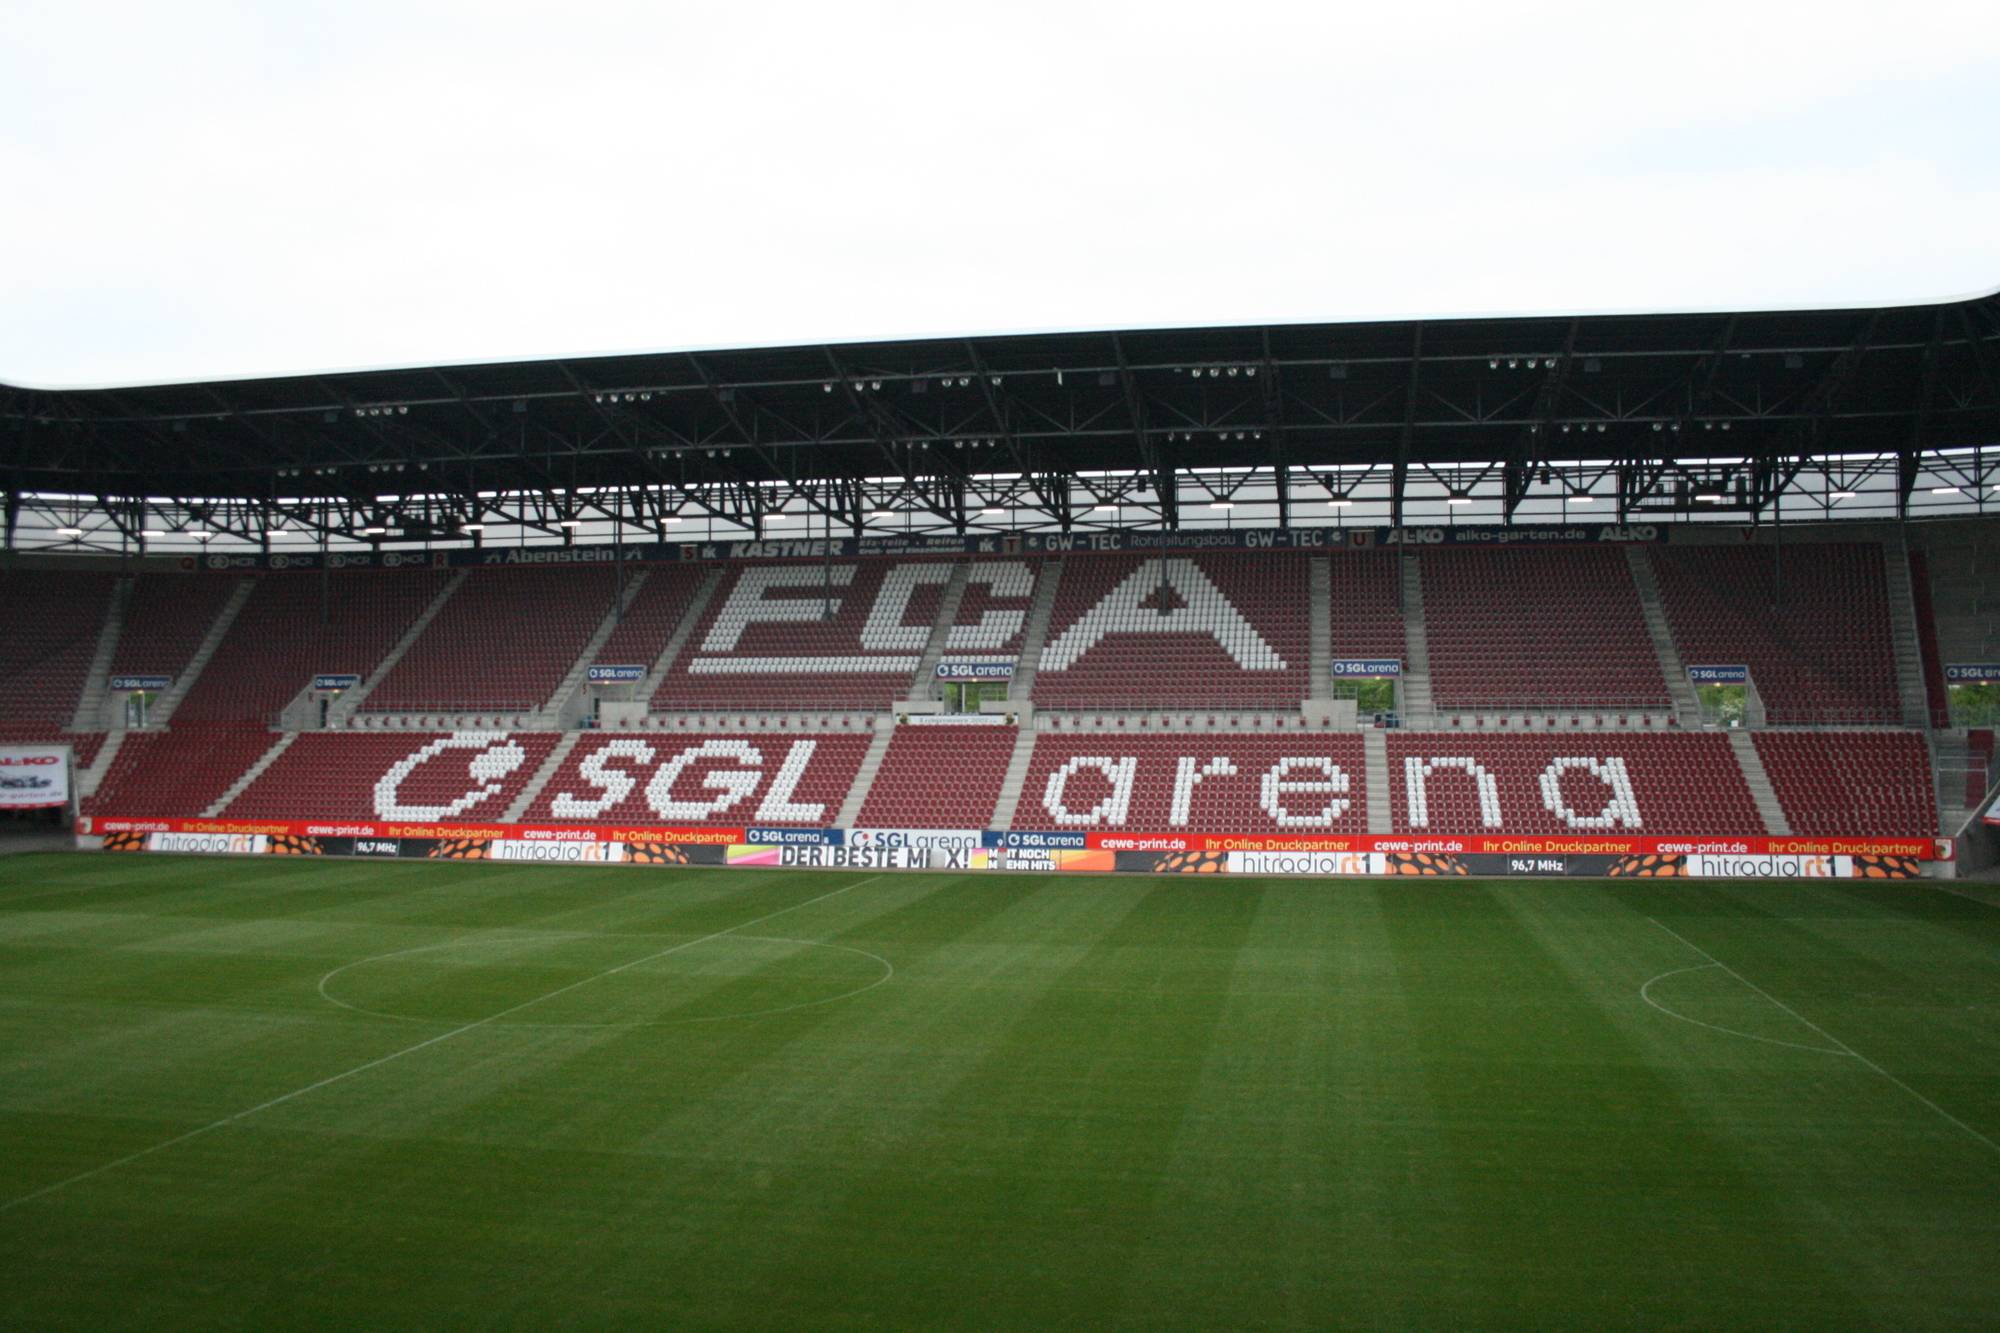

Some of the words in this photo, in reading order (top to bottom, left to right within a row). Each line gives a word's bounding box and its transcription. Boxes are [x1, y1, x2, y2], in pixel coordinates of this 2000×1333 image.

[1386, 529, 1445, 544] AL-KO
[1456, 528, 1586, 543] alko-garten.de
[1598, 525, 1658, 541] AL-KO
[505, 548, 615, 564] Abenstein
[729, 540, 844, 559] KASTNER
[229, 557, 256, 568] NCR
[289, 557, 313, 567] NCR
[346, 555, 371, 566] NCR
[402, 553, 425, 564] NCR
[599, 669, 617, 678] SGL
[951, 665, 975, 676] SGL
[975, 666, 1013, 676] arena
[1346, 663, 1367, 673] SGL
[1367, 664, 1399, 673] arena
[1700, 670, 1718, 679] SGL
[1718, 671, 1745, 679] arena
[1960, 668, 1984, 678] SGL
[123, 679, 142, 688] SGL
[552, 740, 825, 821] SGL
[1042, 756, 1643, 829] arena
[104, 821, 170, 833] cewe-print.de
[183, 822, 195, 832] Ihr
[197, 822, 226, 833] Online
[227, 823, 290, 835] Druckpartner
[307, 825, 374, 836] cewe-print.de
[389, 826, 402, 836] Ihr
[403, 826, 435, 837] Online
[436, 826, 504, 839] Druckpartner
[160, 832, 228, 851] hitradio
[524, 829, 597, 841] cewe-print.de
[613, 831, 627, 841] Ihr
[628, 831, 662, 842] Online
[665, 832, 738, 844] Druckpartner
[762, 830, 785, 842] SGL
[785, 832, 820, 843] arena
[875, 832, 915, 847] SGL
[916, 834, 977, 849] arena
[1022, 835, 1046, 846] SGL
[1047, 836, 1084, 847] arena
[357, 842, 375, 853] 96,7
[376, 842, 397, 852] MHz
[1101, 837, 1186, 850] cewe-print.de
[1205, 839, 1221, 849] Ihr
[1224, 839, 1263, 850] Online
[1266, 839, 1350, 852] Druckpartner
[1374, 840, 1463, 853] cewe-print.de
[1483, 841, 1499, 852] Ihr
[1502, 841, 1542, 852] Online
[1545, 841, 1632, 854] Druckpartner
[1657, 841, 1748, 854] cewe-print.de
[1768, 842, 1784, 853] Ihr
[1787, 842, 1829, 853] Online
[1832, 842, 1923, 855] Druckpartner
[502, 842, 580, 860] hitradio
[782, 846, 822, 866] DER
[833, 847, 899, 867] BESTE
[1018, 850, 1050, 860] NOCH
[1030, 860, 1056, 871] HITS
[1243, 852, 1334, 873] hitradio
[1511, 859, 1536, 873] 96,7
[1538, 860, 1563, 871] MHz
[1702, 855, 1798, 877] hitradio
